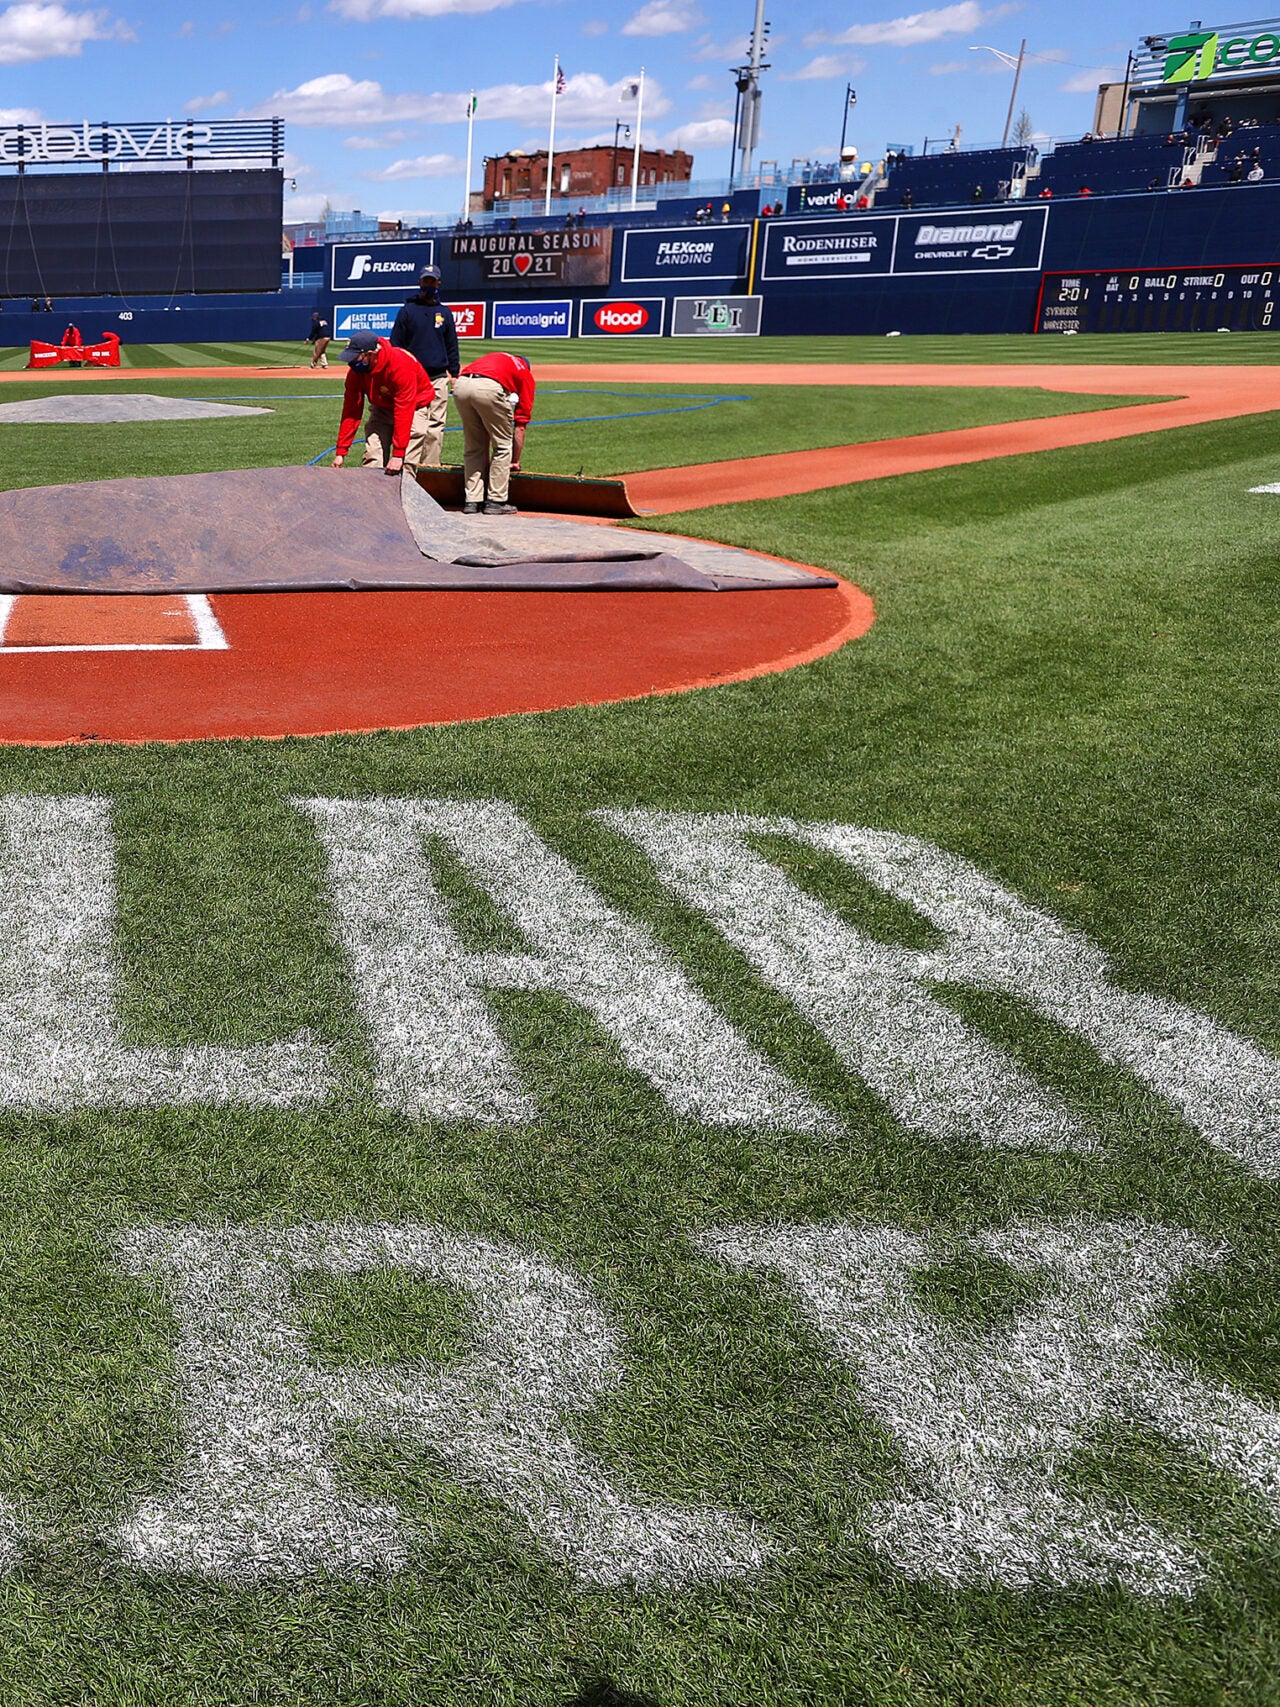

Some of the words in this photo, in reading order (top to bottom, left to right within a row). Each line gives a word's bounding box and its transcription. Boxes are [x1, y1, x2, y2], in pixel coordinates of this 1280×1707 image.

[914, 220, 1023, 245] Diamond
[454, 236, 535, 253] INAUGURAL
[543, 233, 601, 249] SEASON
[782, 236, 878, 252] RODENHISER
[655, 253, 712, 265] LANDING
[914, 250, 969, 259] CHEVROLET
[492, 259, 510, 273] 20
[535, 257, 552, 271] 21
[1061, 279, 1080, 287] TIME
[1129, 276, 1140, 290] 0
[1144, 278, 1166, 287] BALL
[1166, 275, 1177, 289] 0
[1183, 276, 1214, 286] STRIKE
[1213, 273, 1225, 288] 0
[1240, 274, 1260, 284] OUT
[1261, 271, 1273, 285] 0
[1106, 283, 1120, 292] BAT
[1058, 288, 1089, 301] 2:01
[1104, 294, 1108, 302] 1
[1117, 294, 1123, 302] 2
[1132, 293, 1137, 301] 3
[1148, 293, 1153, 301] 4
[1179, 292, 1185, 300] 6
[1195, 292, 1201, 300] 7
[1211, 291, 1217, 299] 8
[1228, 291, 1234, 299] 9
[1243, 290, 1252, 299] 10
[1264, 290, 1271, 298] R
[1045, 306, 1079, 316] SYRACUSE
[1264, 302, 1274, 313] 0
[118, 312, 133, 320] 403
[498, 311, 565, 328] nationalgrid
[600, 310, 642, 325] Hood
[693, 301, 743, 328] LEI
[1262, 314, 1272, 326] 0
[352, 322, 371, 330] METAL
[372, 321, 395, 329] ROOFIN
[1043, 320, 1080, 330] WORCESTER
